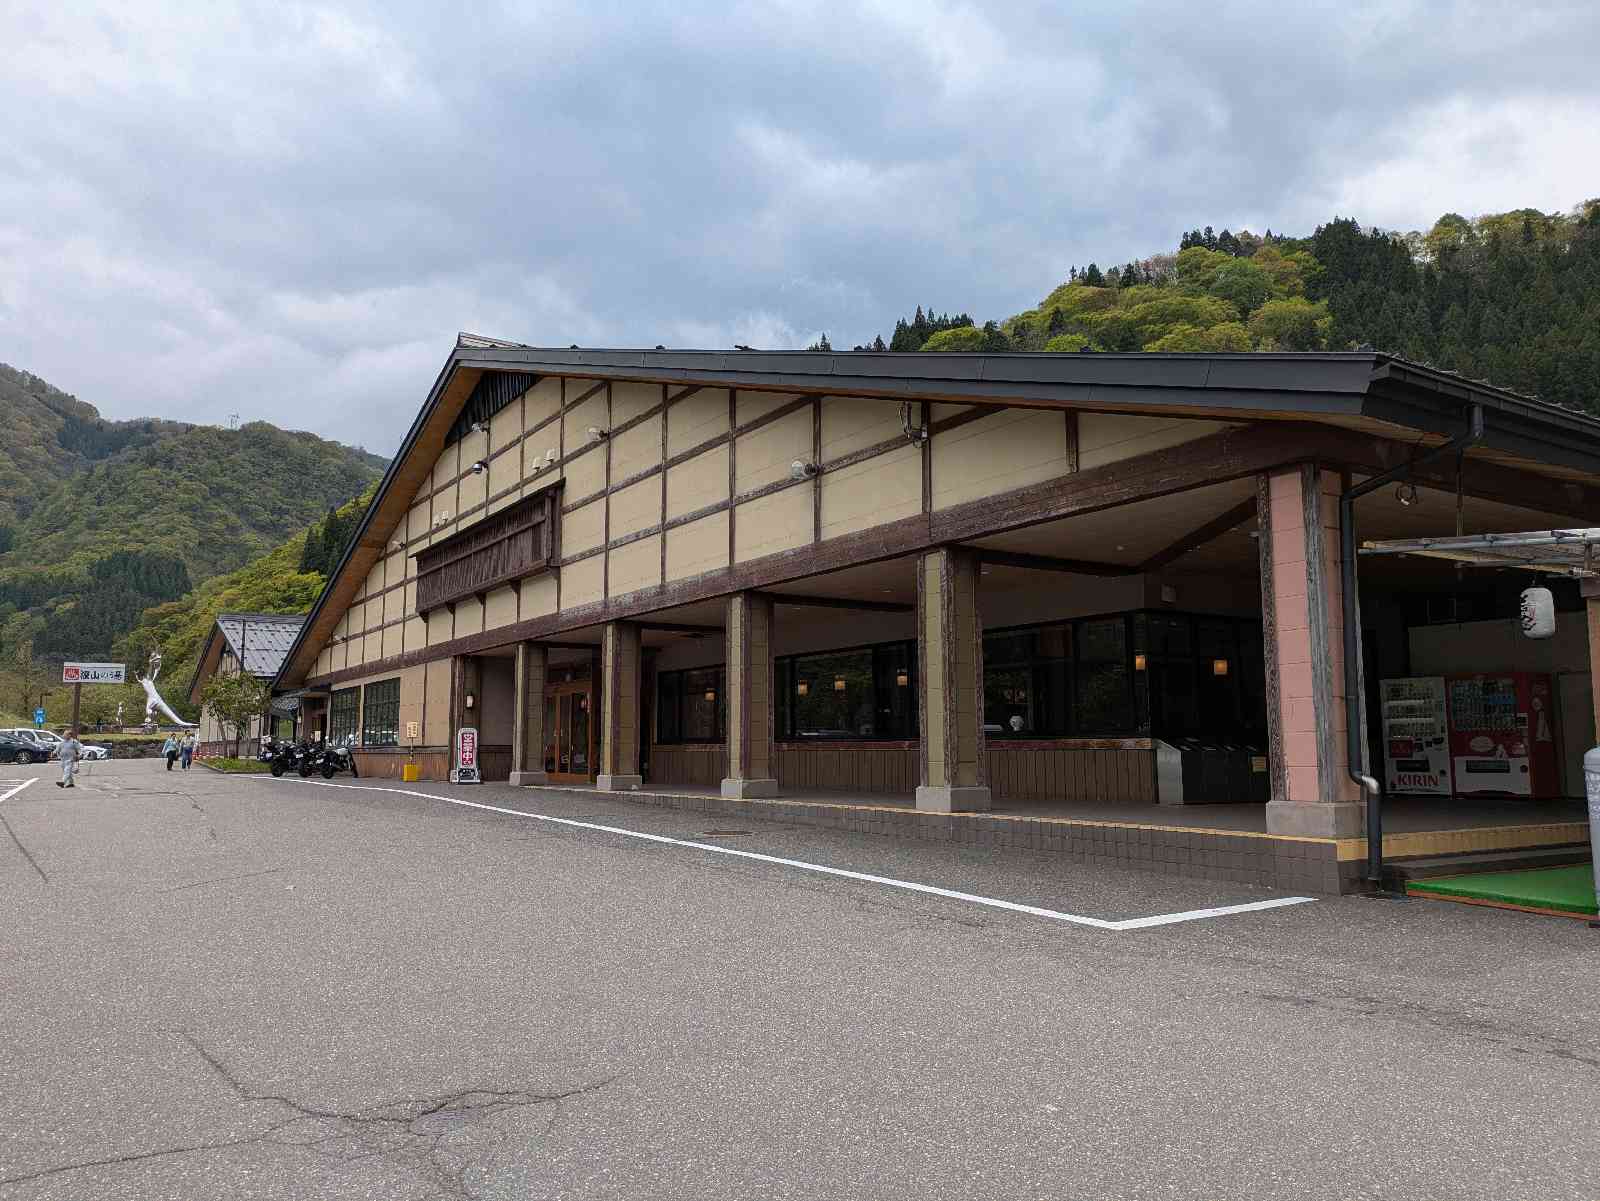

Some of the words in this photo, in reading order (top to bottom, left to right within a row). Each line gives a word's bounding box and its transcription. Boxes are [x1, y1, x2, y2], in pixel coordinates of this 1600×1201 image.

[463, 734, 473, 761] 営業中
[1398, 775, 1439, 786] KIRIN
